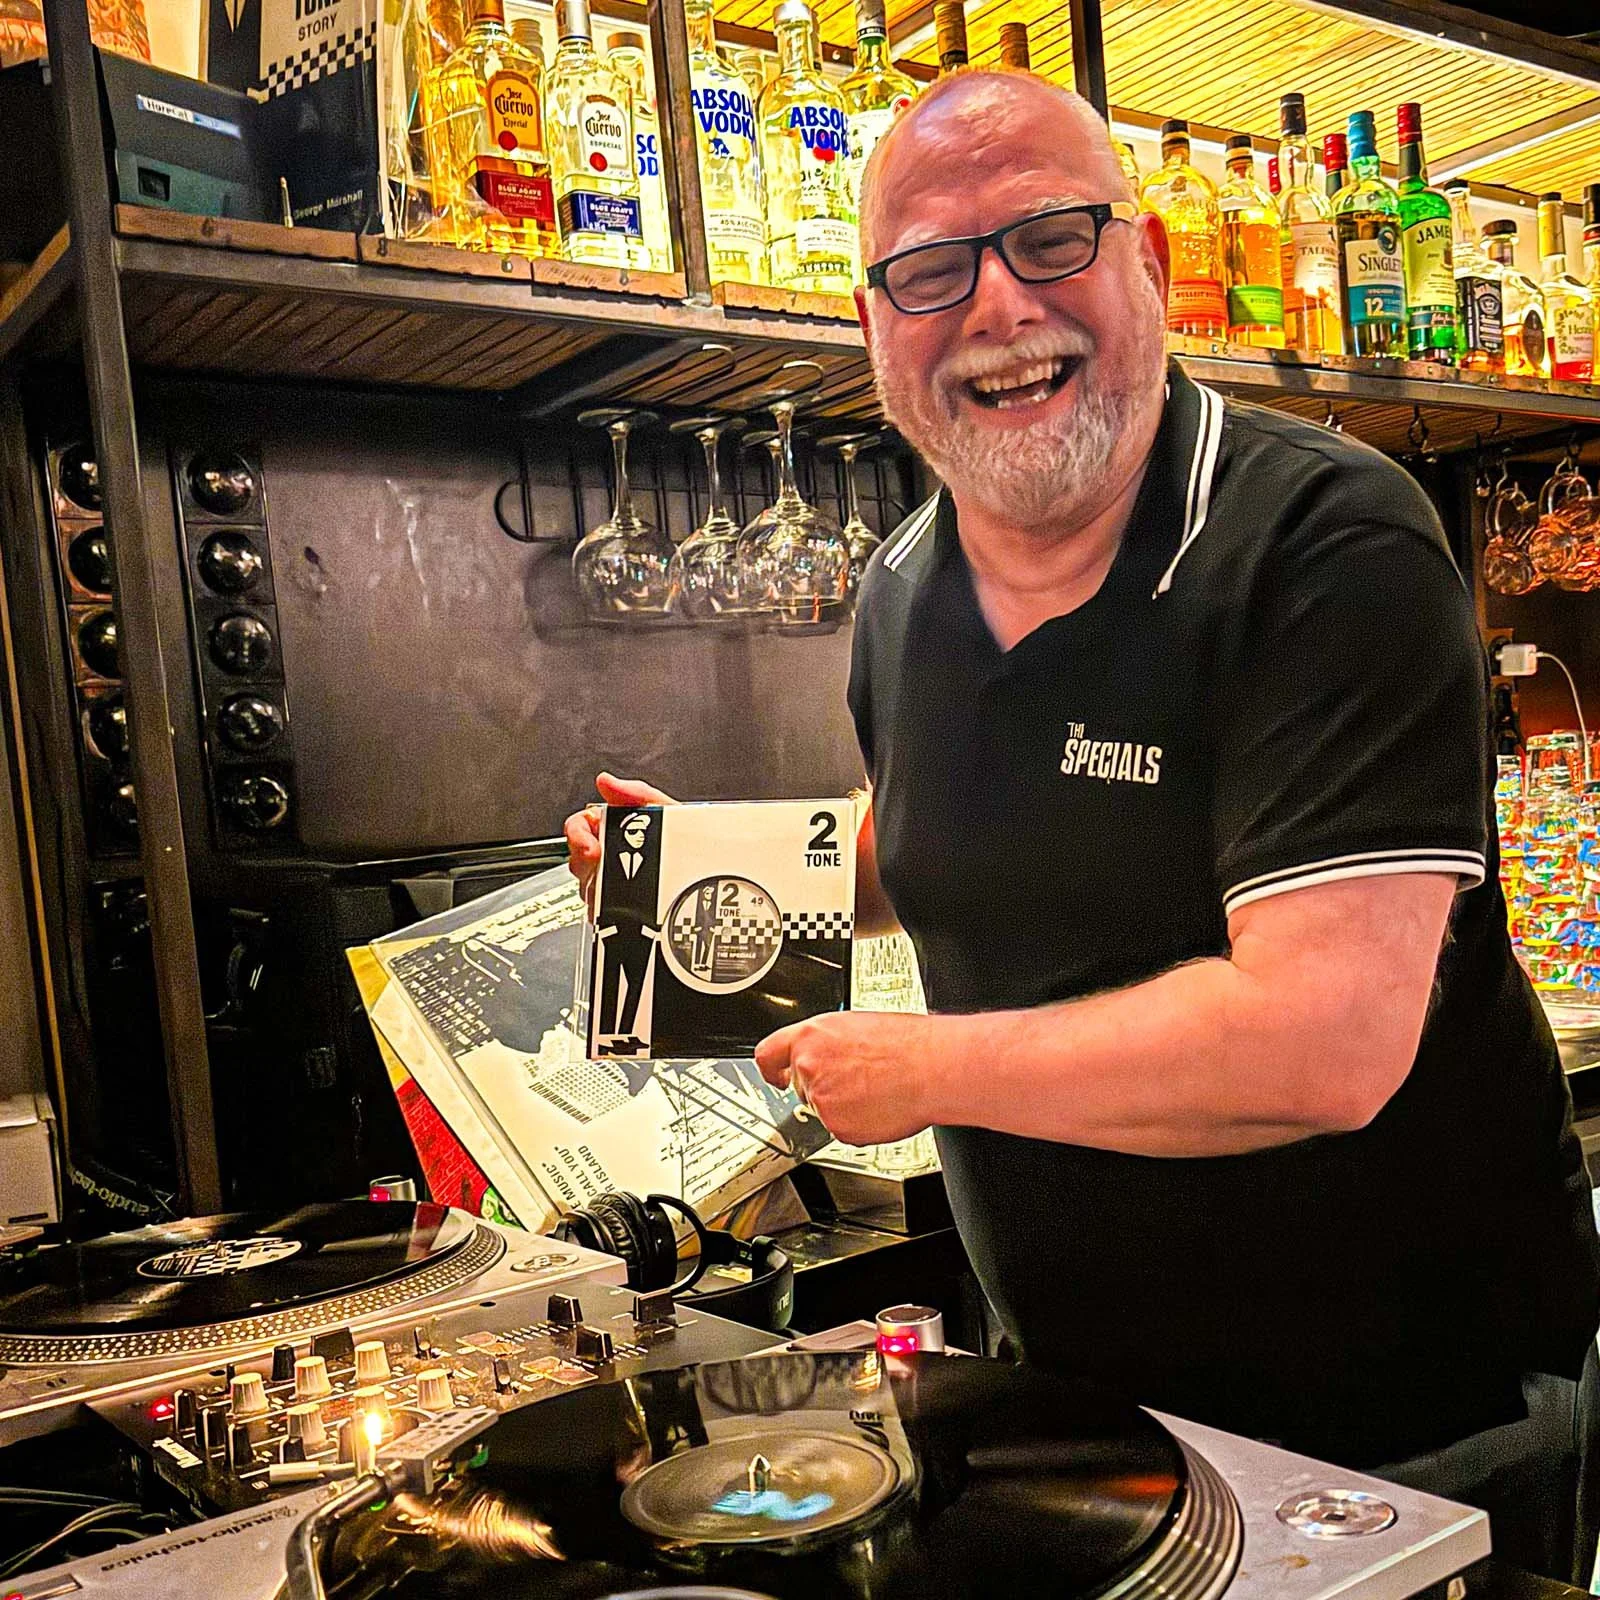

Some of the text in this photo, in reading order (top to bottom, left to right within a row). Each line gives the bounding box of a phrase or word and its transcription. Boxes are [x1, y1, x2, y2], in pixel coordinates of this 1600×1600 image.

[298, 12, 338, 41] STORY
[494, 93, 534, 117] Cuervo
[690, 88, 754, 120] ABSOL
[585, 116, 622, 138] Cuervo
[699, 111, 757, 143] VODK
[789, 106, 848, 132] ABSOL
[1417, 224, 1451, 244] JAME
[1358, 252, 1402, 273] SINGLE
[1364, 297, 1385, 317] 12
[1060, 738, 1164, 785] SPECIALS
[808, 810, 838, 851] 2
[804, 853, 842, 868] TONE
[721, 882, 740, 907] 2
[719, 908, 742, 918] TONE
[577, 1145, 609, 1184] ISLAND
[575, 1169, 598, 1198] CALL
